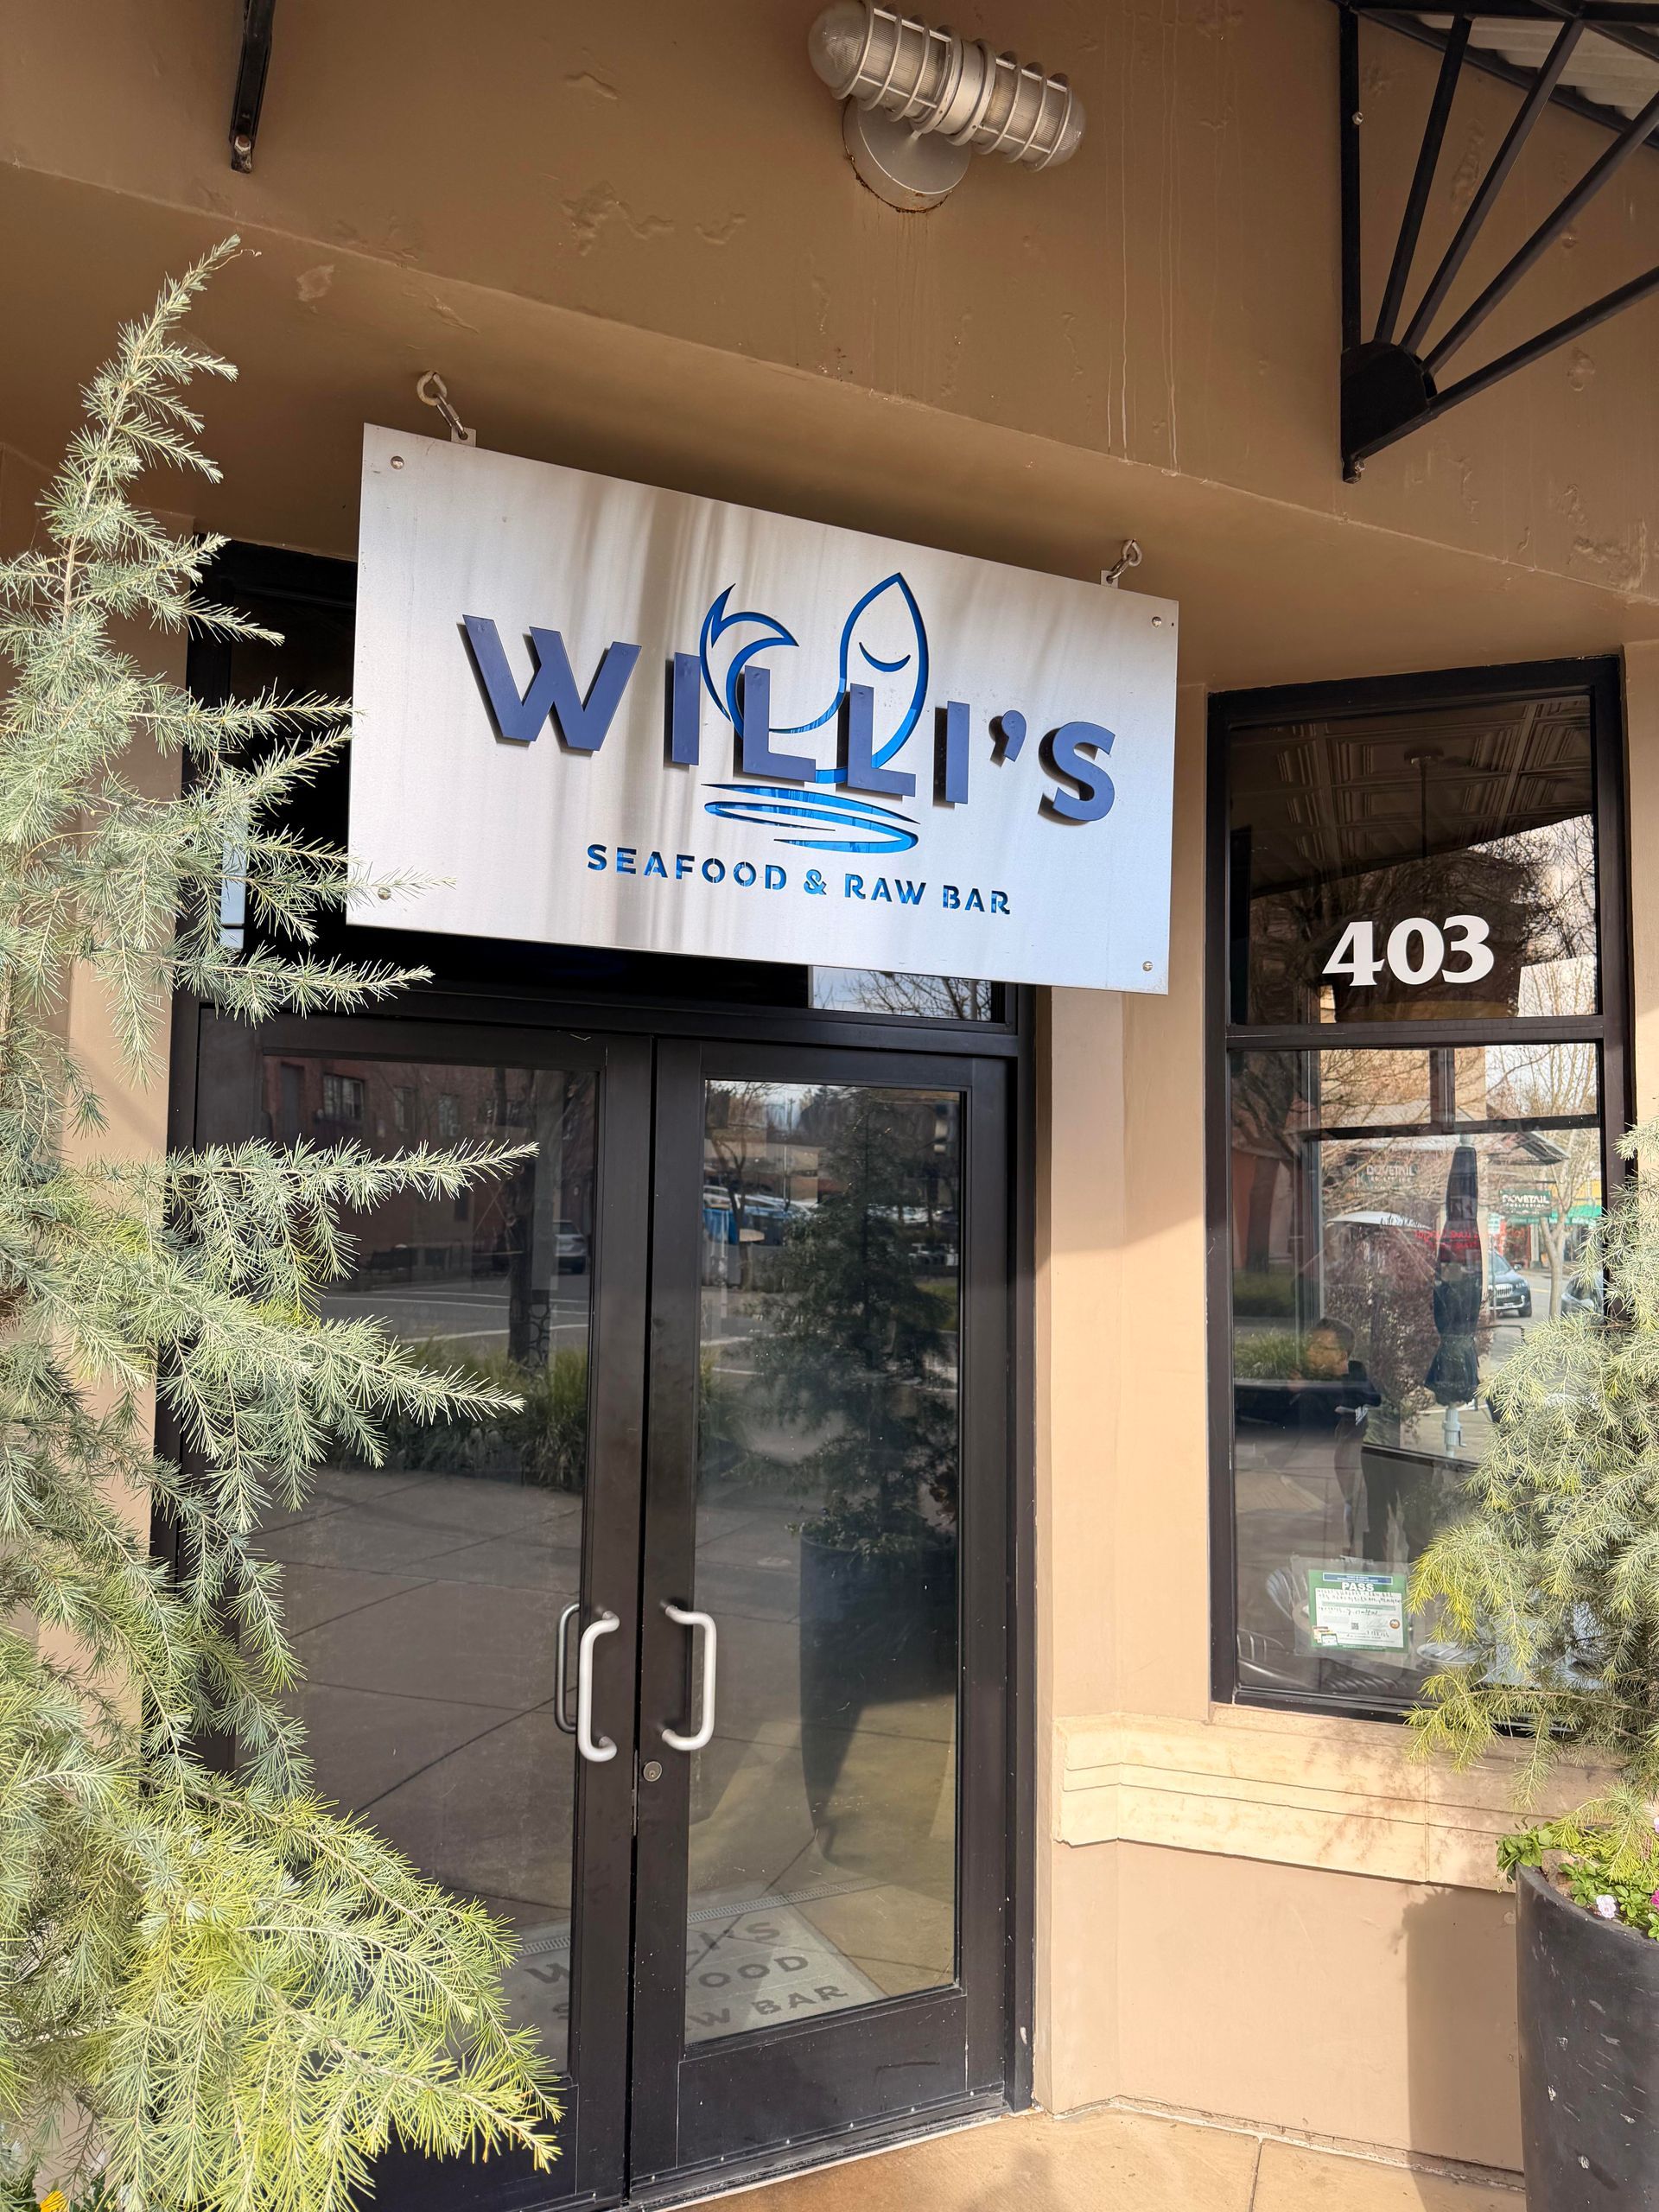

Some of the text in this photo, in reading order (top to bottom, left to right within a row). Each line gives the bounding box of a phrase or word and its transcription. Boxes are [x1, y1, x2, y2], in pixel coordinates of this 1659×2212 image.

[461, 613, 1116, 823] WILLI'S
[587, 843, 1011, 916] SEAFOOD & RAW BAR
[1321, 914, 1495, 987] 403
[1341, 1581, 1375, 1592] PASS
[750, 1985, 849, 2016] BAR
